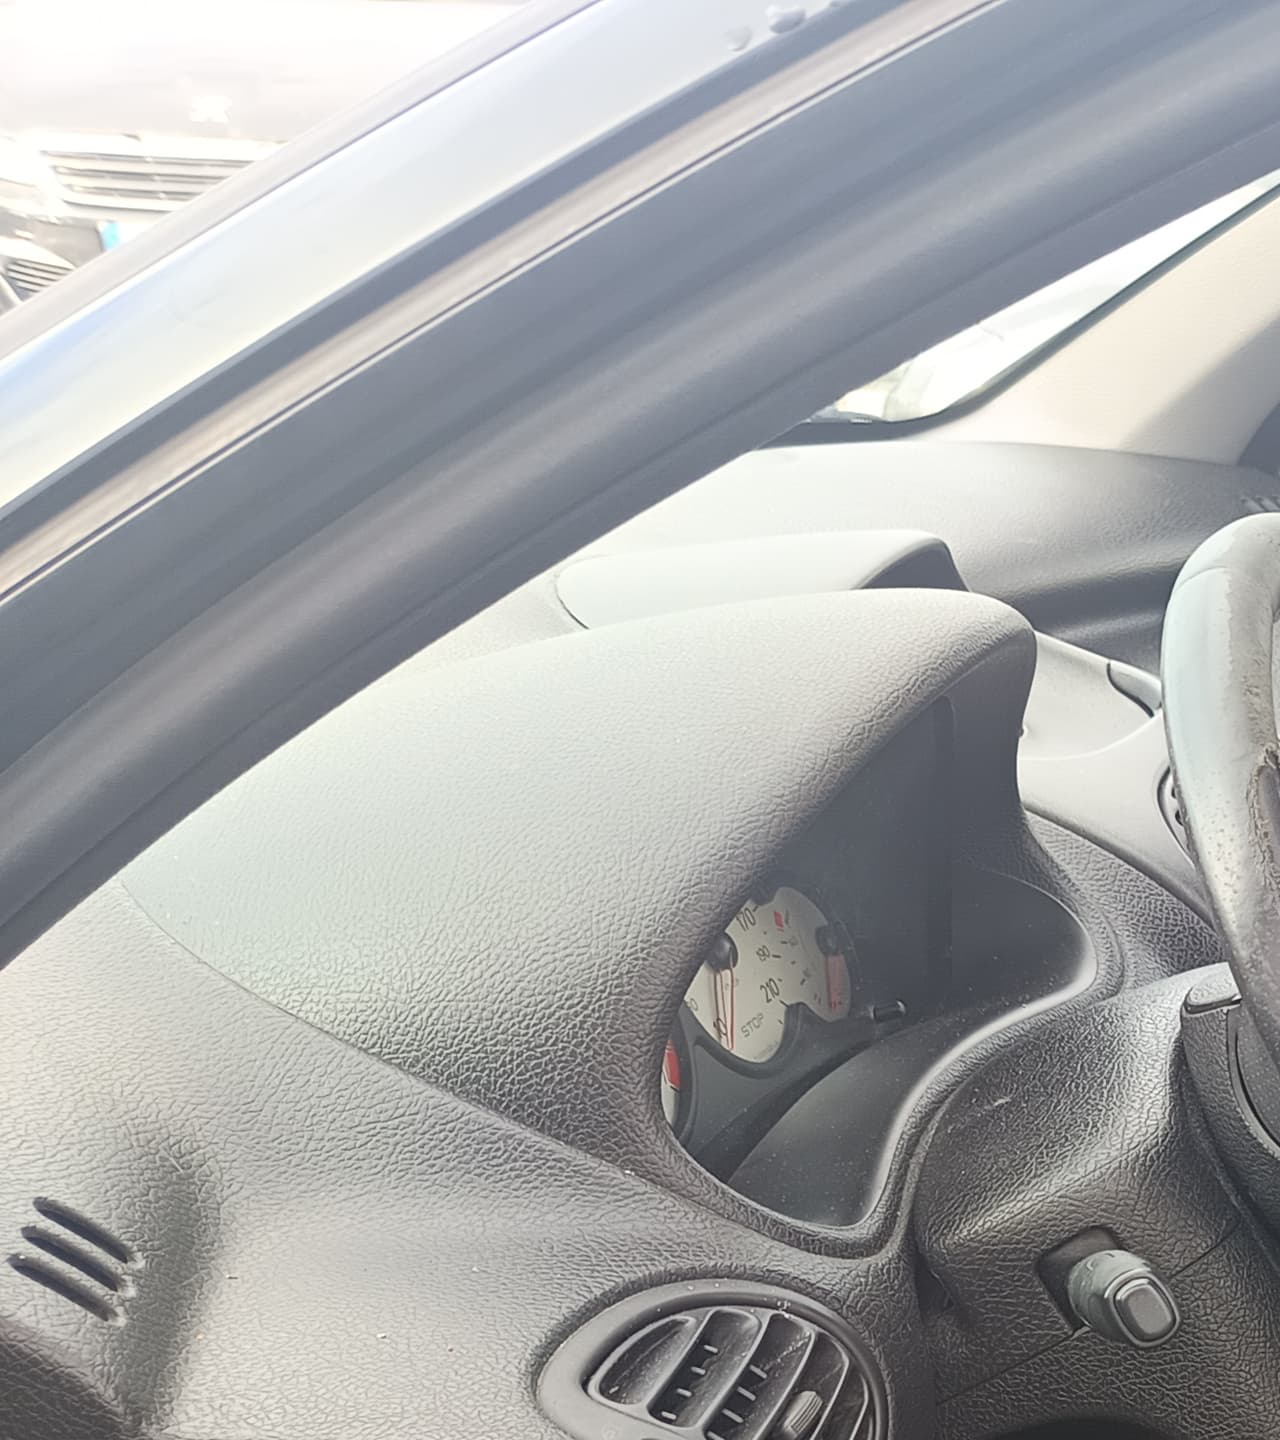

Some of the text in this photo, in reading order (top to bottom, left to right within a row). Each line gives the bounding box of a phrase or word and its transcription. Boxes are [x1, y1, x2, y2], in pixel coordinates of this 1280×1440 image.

[736, 907, 756, 931] 170
[760, 978, 779, 1003] 210
[741, 1013, 763, 1038] STOP
